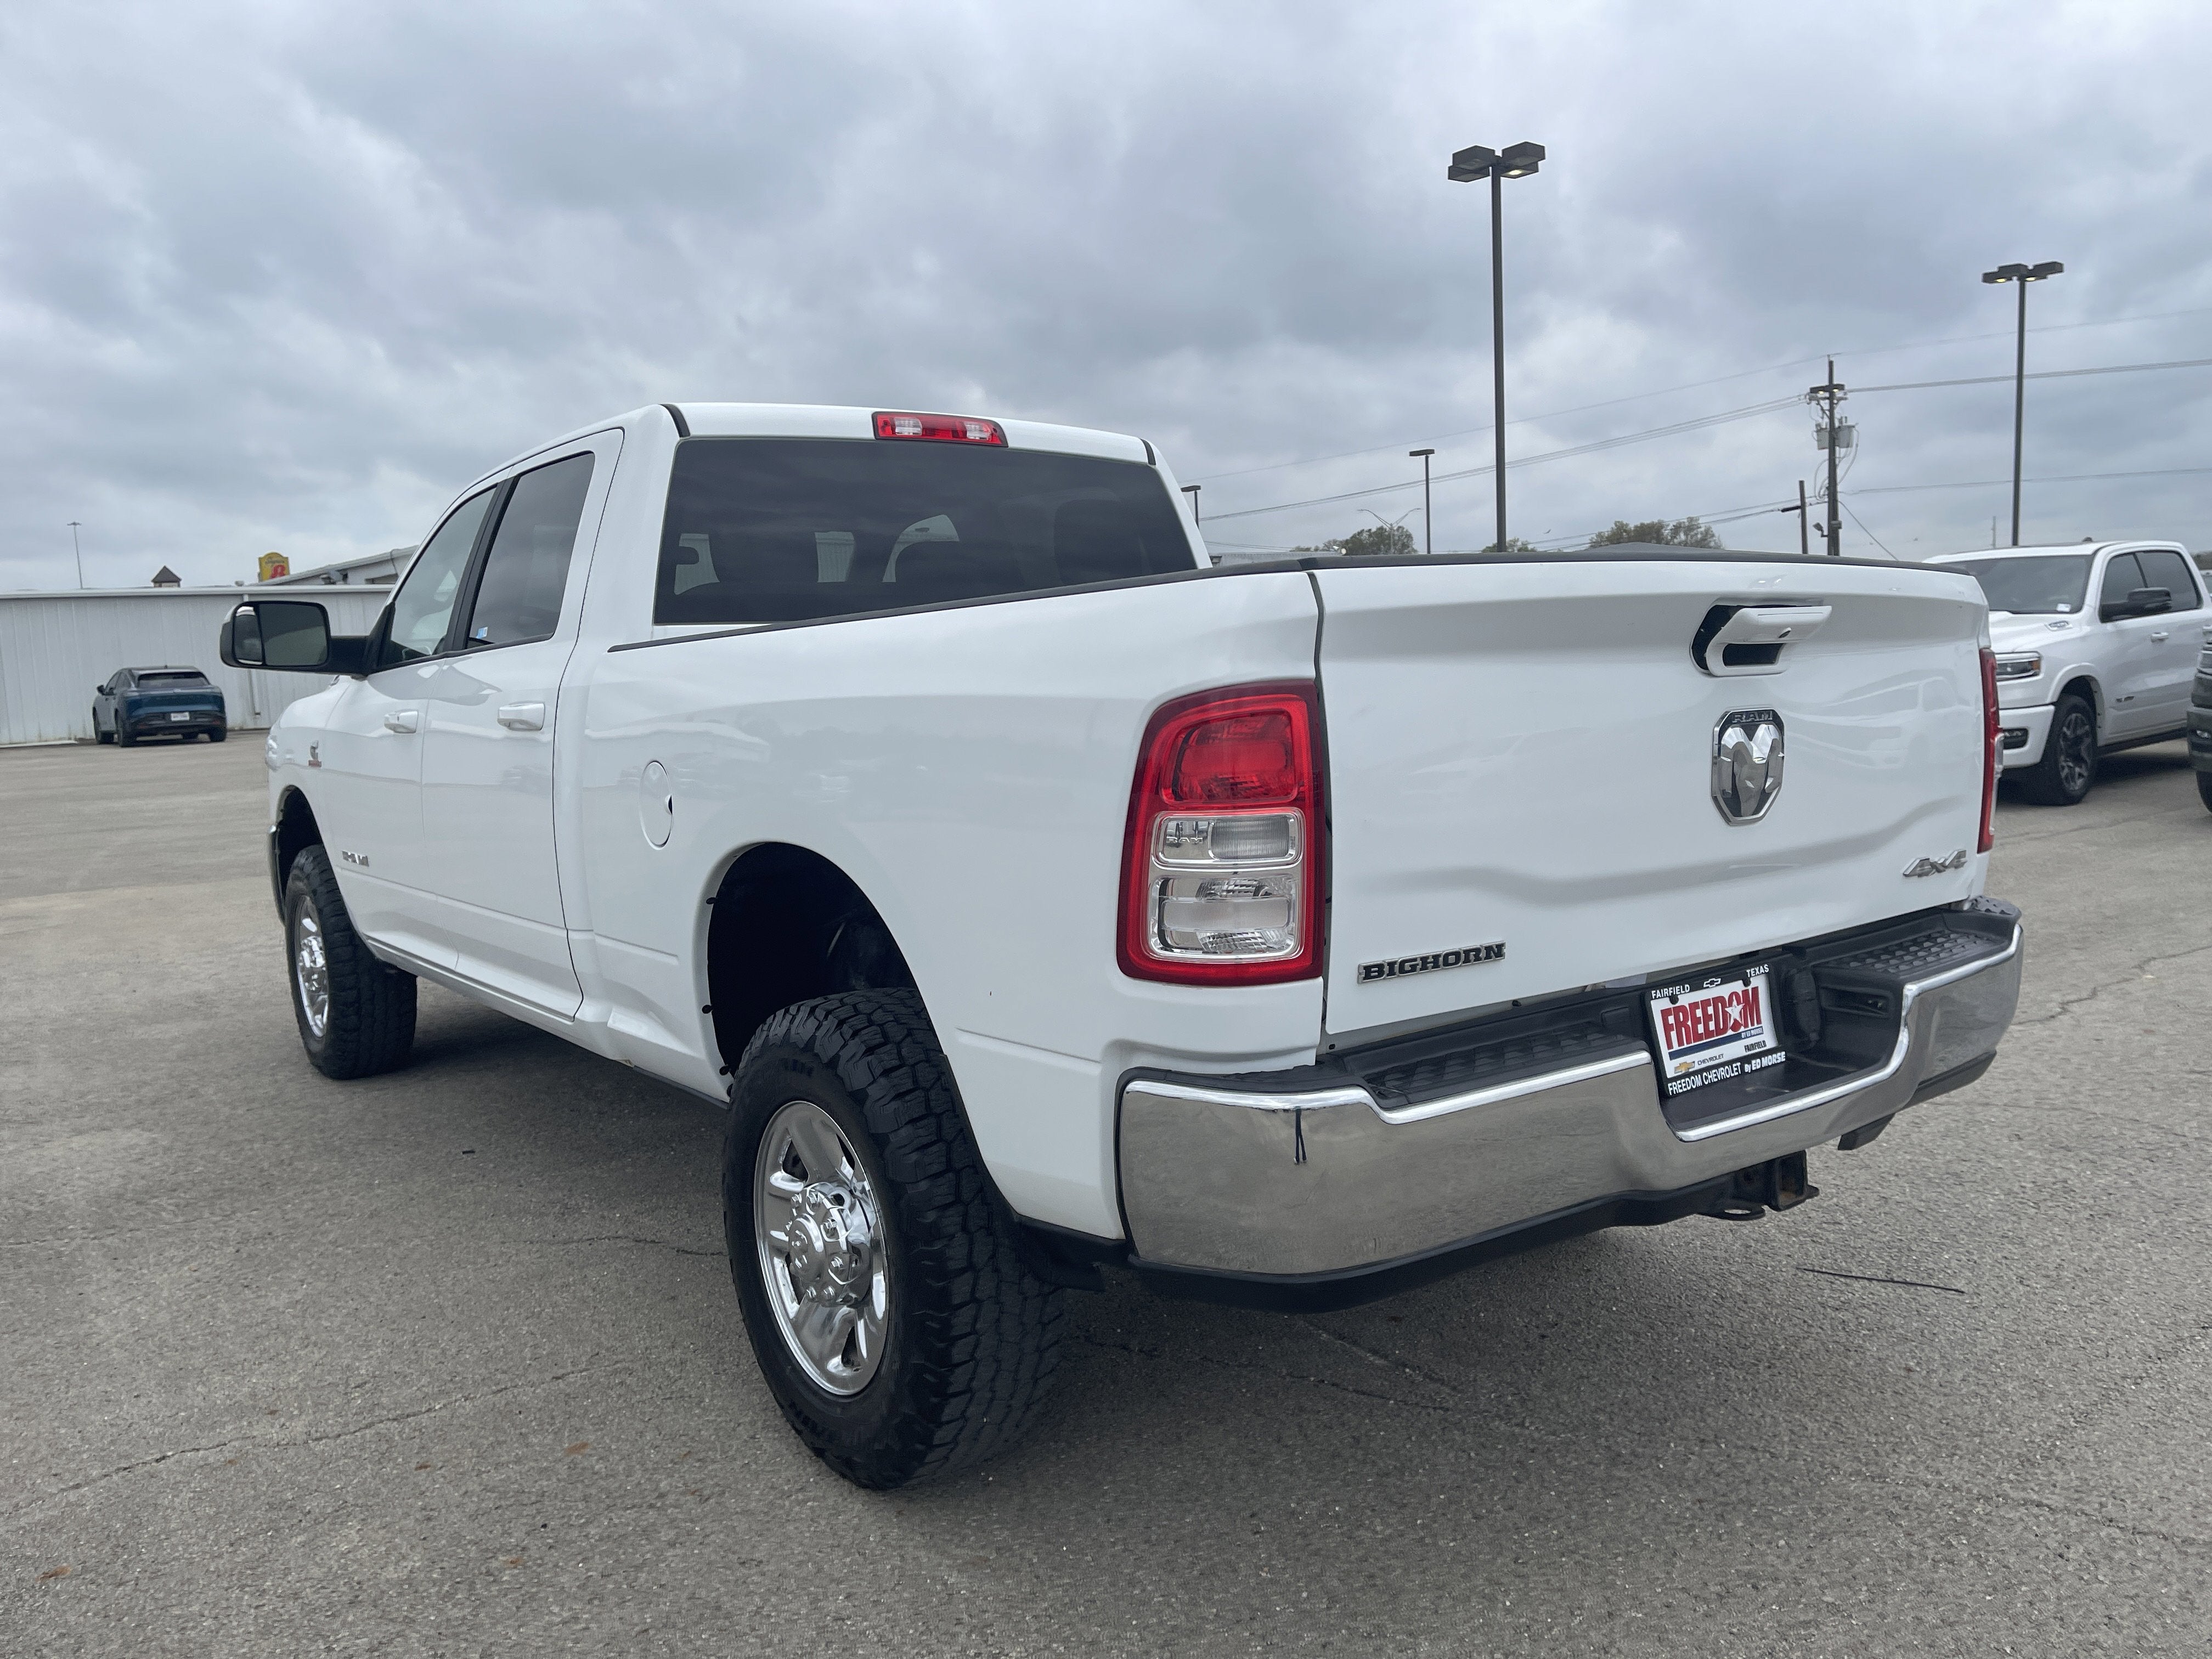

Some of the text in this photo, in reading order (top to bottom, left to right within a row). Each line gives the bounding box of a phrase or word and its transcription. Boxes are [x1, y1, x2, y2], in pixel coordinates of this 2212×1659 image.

[1732, 710, 1773, 723] RAM
[1357, 940, 1506, 984] BIGHORN
[1651, 963, 1770, 1000] FAIRFIELD TEXAS
[1660, 986, 1762, 1051] FREEDOM
[1697, 1053, 1724, 1066] CHEVROLET
[1744, 1040, 1767, 1053] FAIRFIELD
[1668, 1075, 1702, 1096] FREEDOM
[1702, 1062, 1742, 1085] CHEVROLET
[1751, 1058, 1761, 1070] ED
[1762, 1051, 1786, 1068] MORSE
